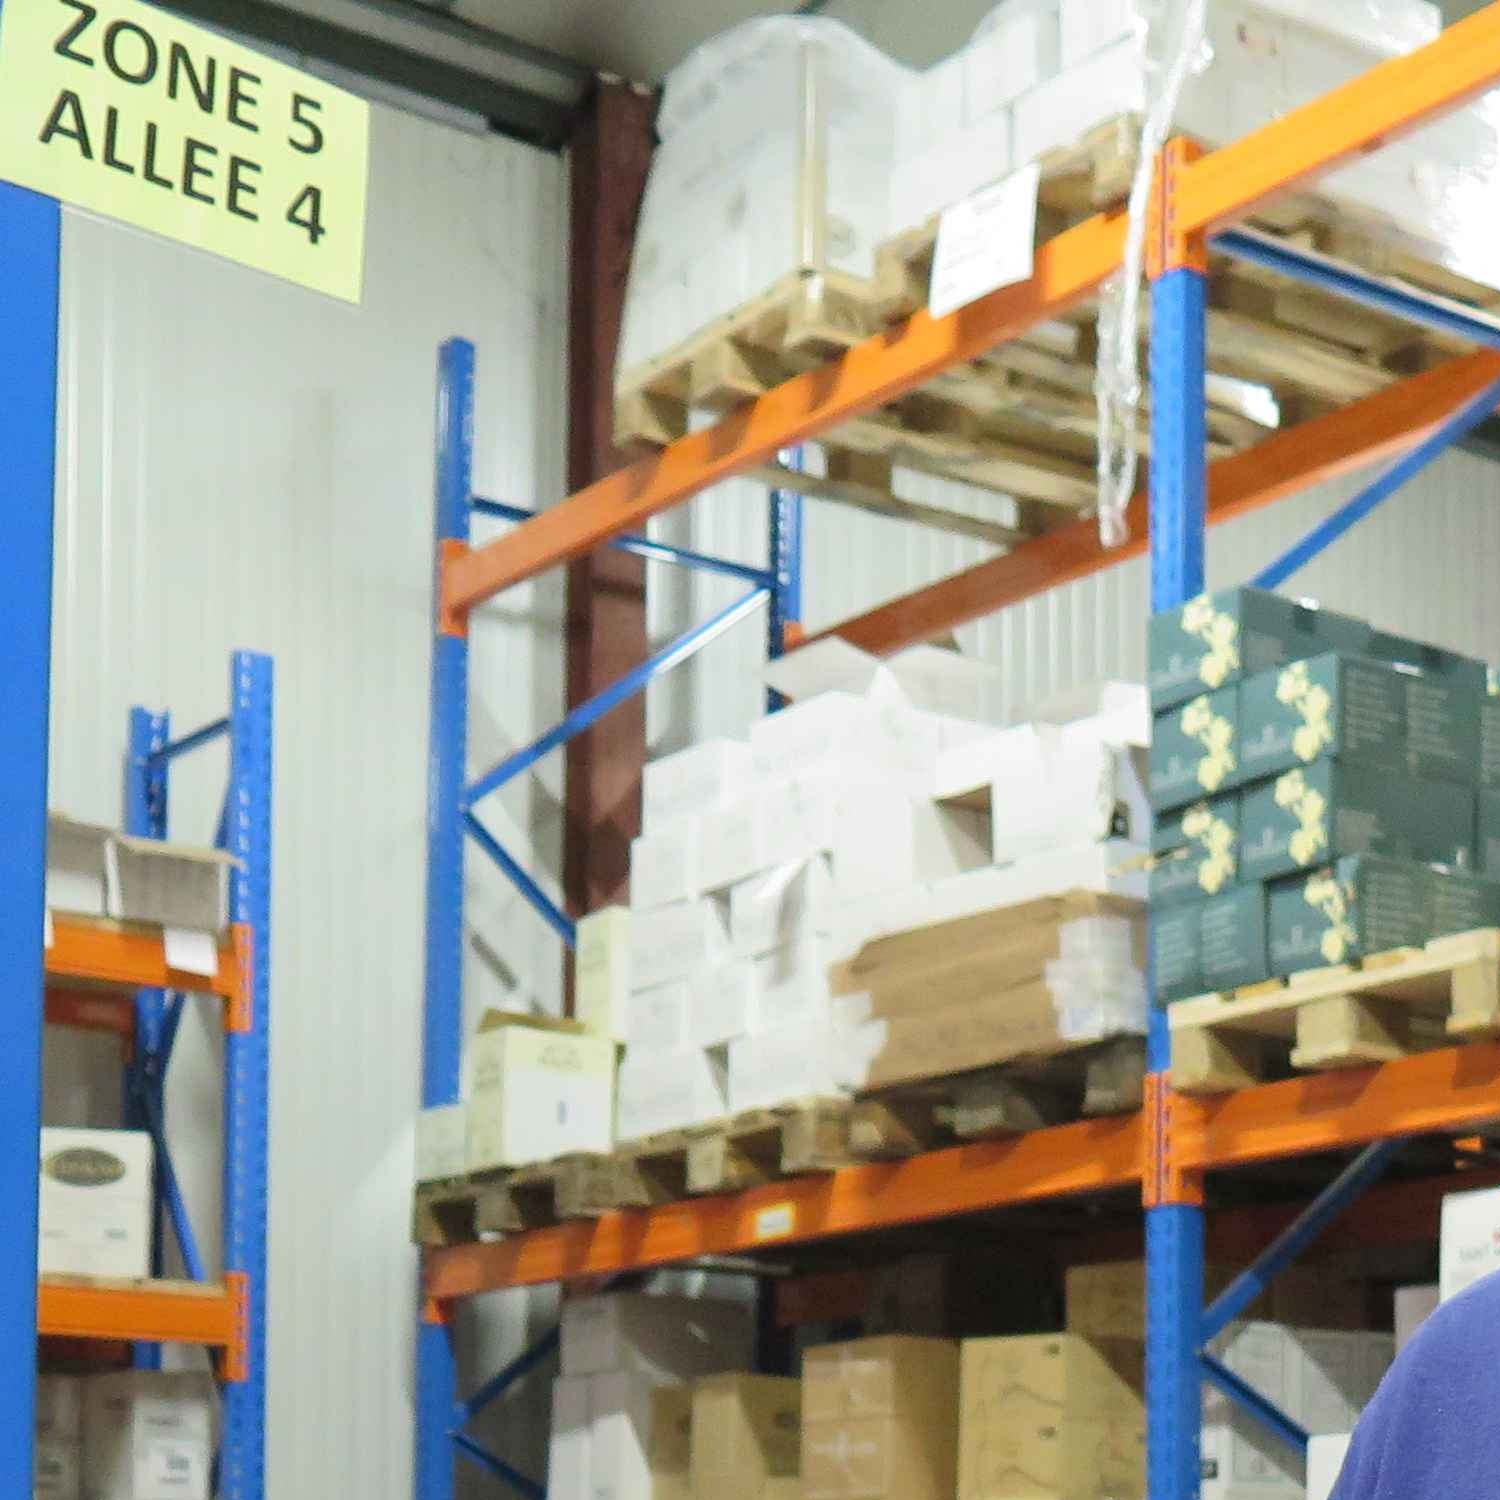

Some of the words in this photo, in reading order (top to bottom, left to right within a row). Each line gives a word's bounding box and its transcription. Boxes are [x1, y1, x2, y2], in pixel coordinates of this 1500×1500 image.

[54, 0, 262, 133] ZONE
[288, 93, 324, 155] 5
[39, 89, 262, 222] ALLEE
[286, 184, 326, 244] 4
